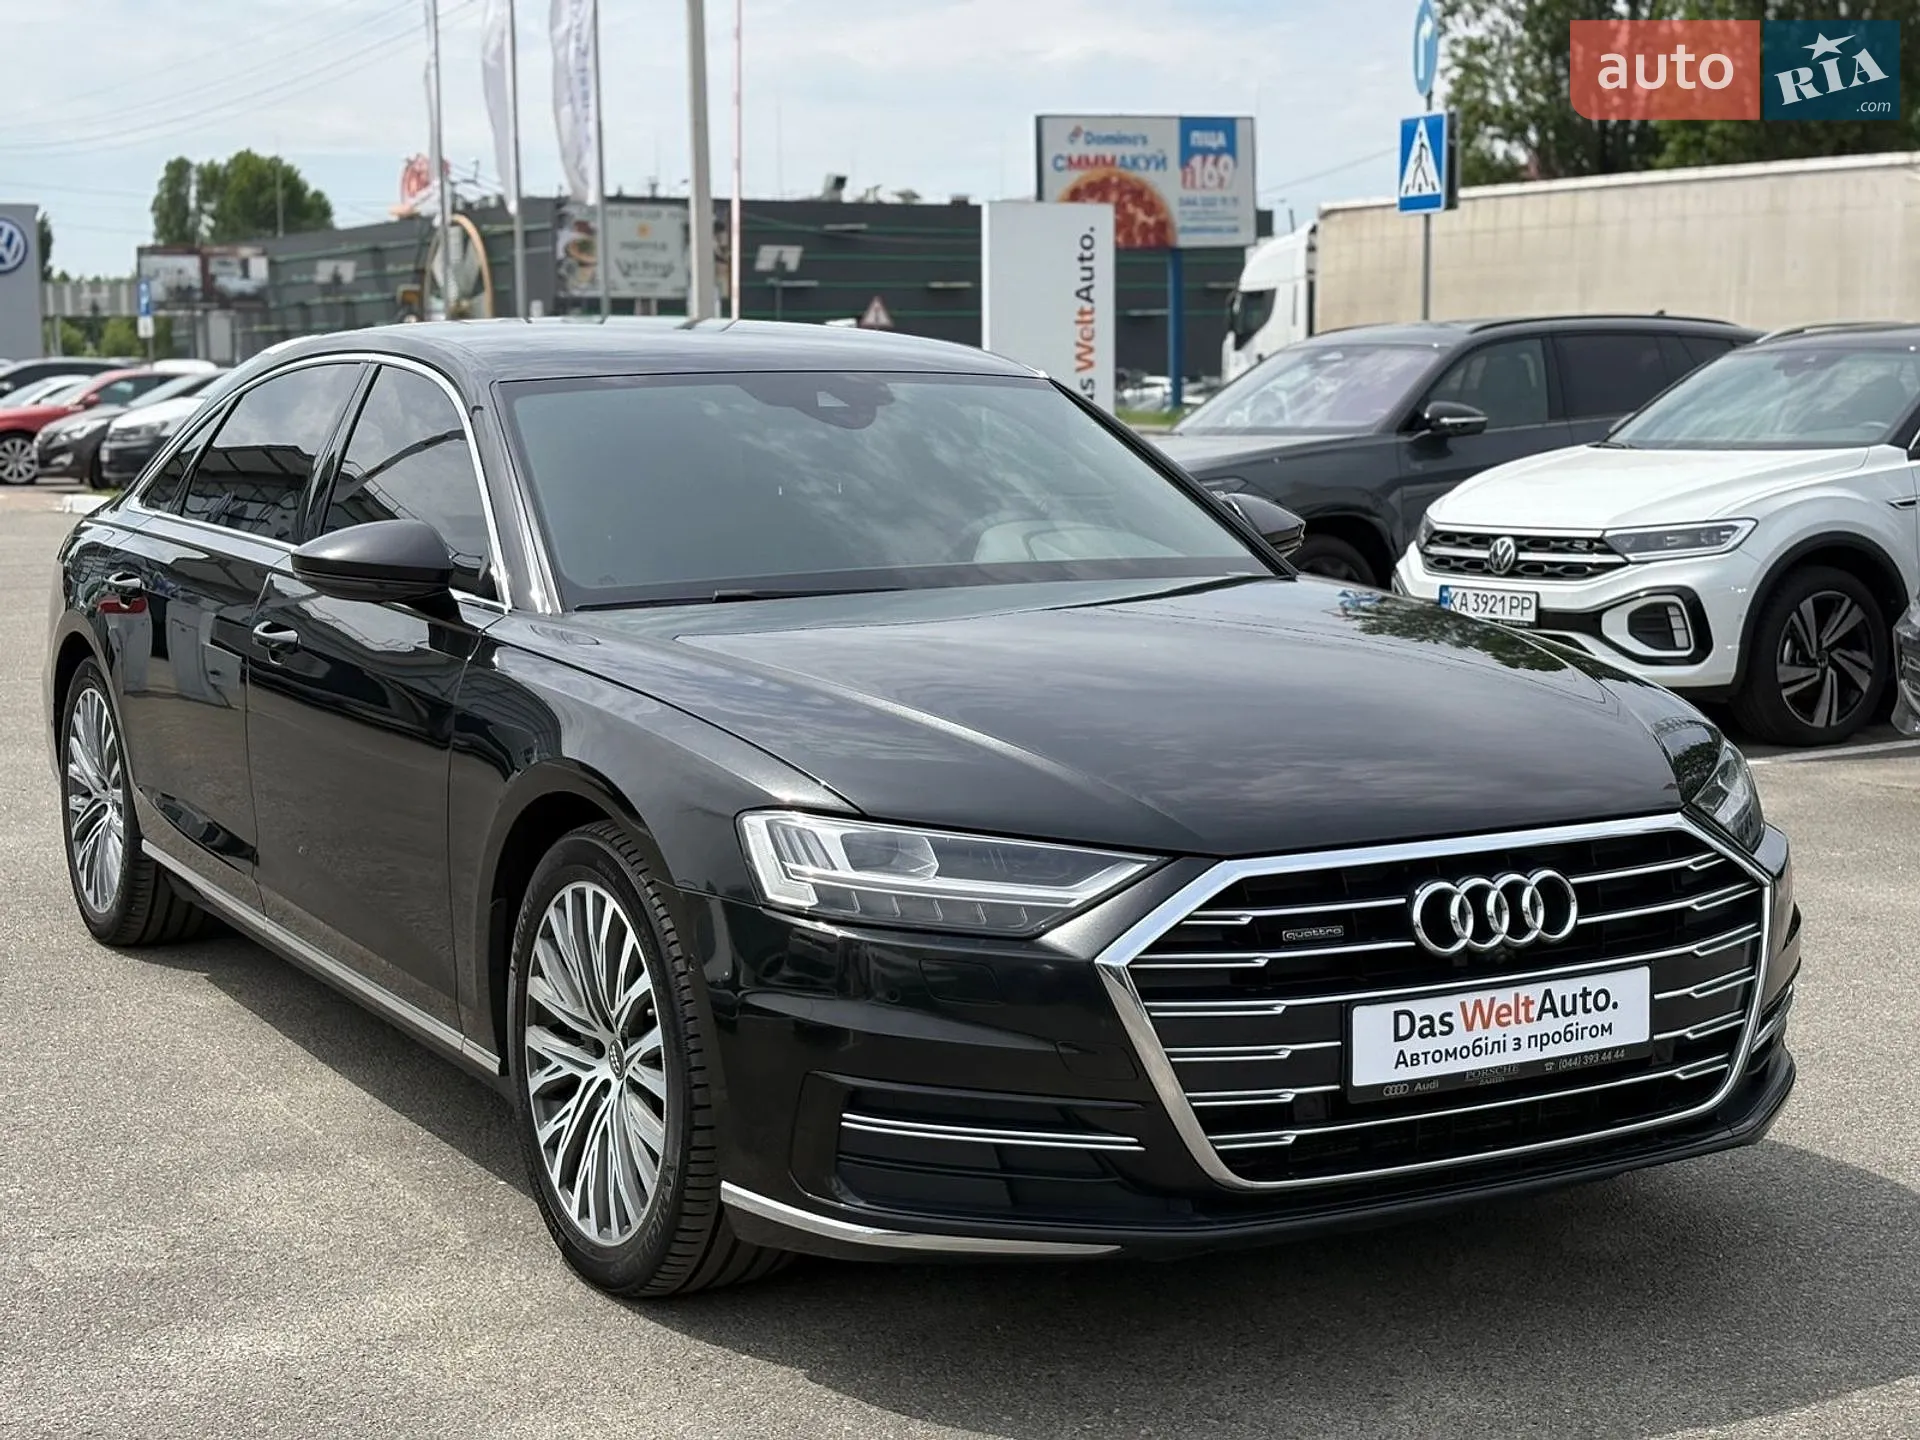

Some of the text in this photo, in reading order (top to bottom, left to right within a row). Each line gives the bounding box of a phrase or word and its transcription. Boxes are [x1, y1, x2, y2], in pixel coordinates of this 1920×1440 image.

[1285, 928, 1342, 940] quattro
[1393, 986, 1619, 1043] Das WeltAuto.
[1394, 1020, 1614, 1070] Автомобілі з пробігом
[1464, 1064, 1520, 1081] PORSCHE
[1414, 1079, 1439, 1092] Audi
